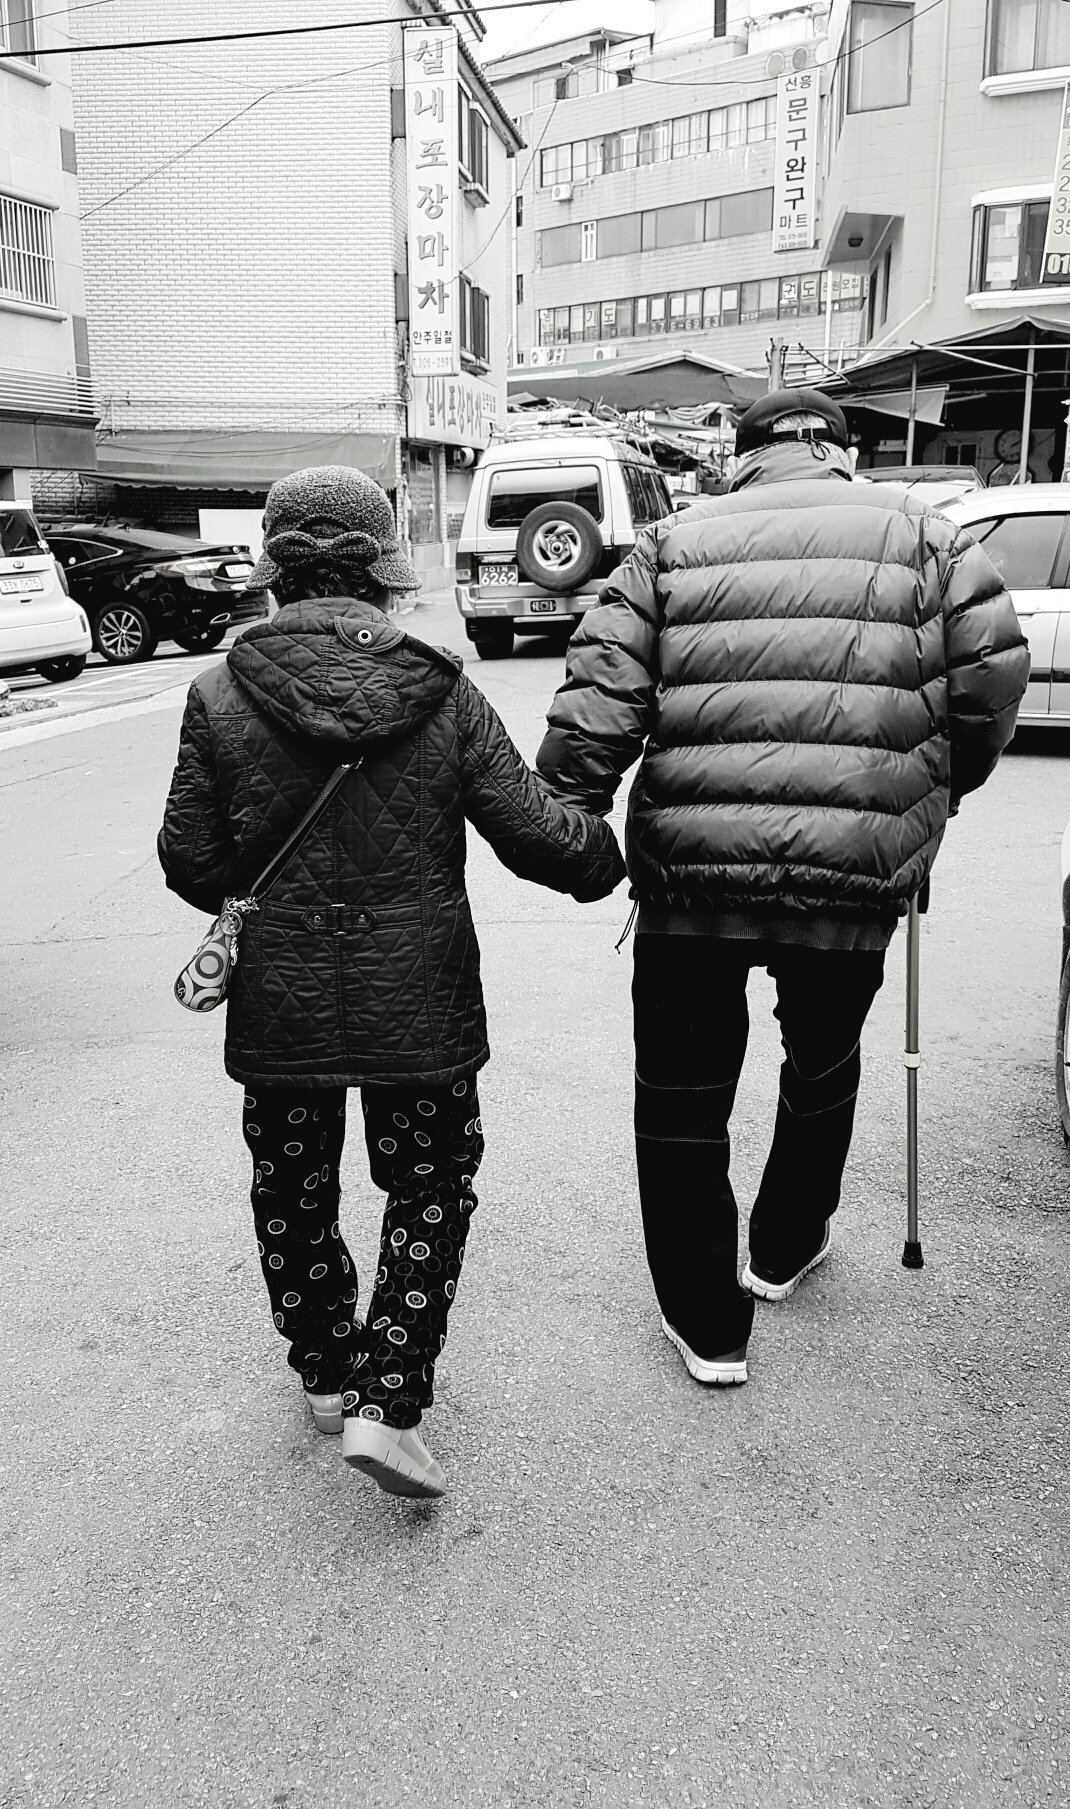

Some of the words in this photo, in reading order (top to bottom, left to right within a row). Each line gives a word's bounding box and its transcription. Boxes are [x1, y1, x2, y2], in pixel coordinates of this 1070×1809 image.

[785, 74, 812, 92] 선흥
[780, 213, 808, 229] 마트
[481, 572, 516, 585] 6262
